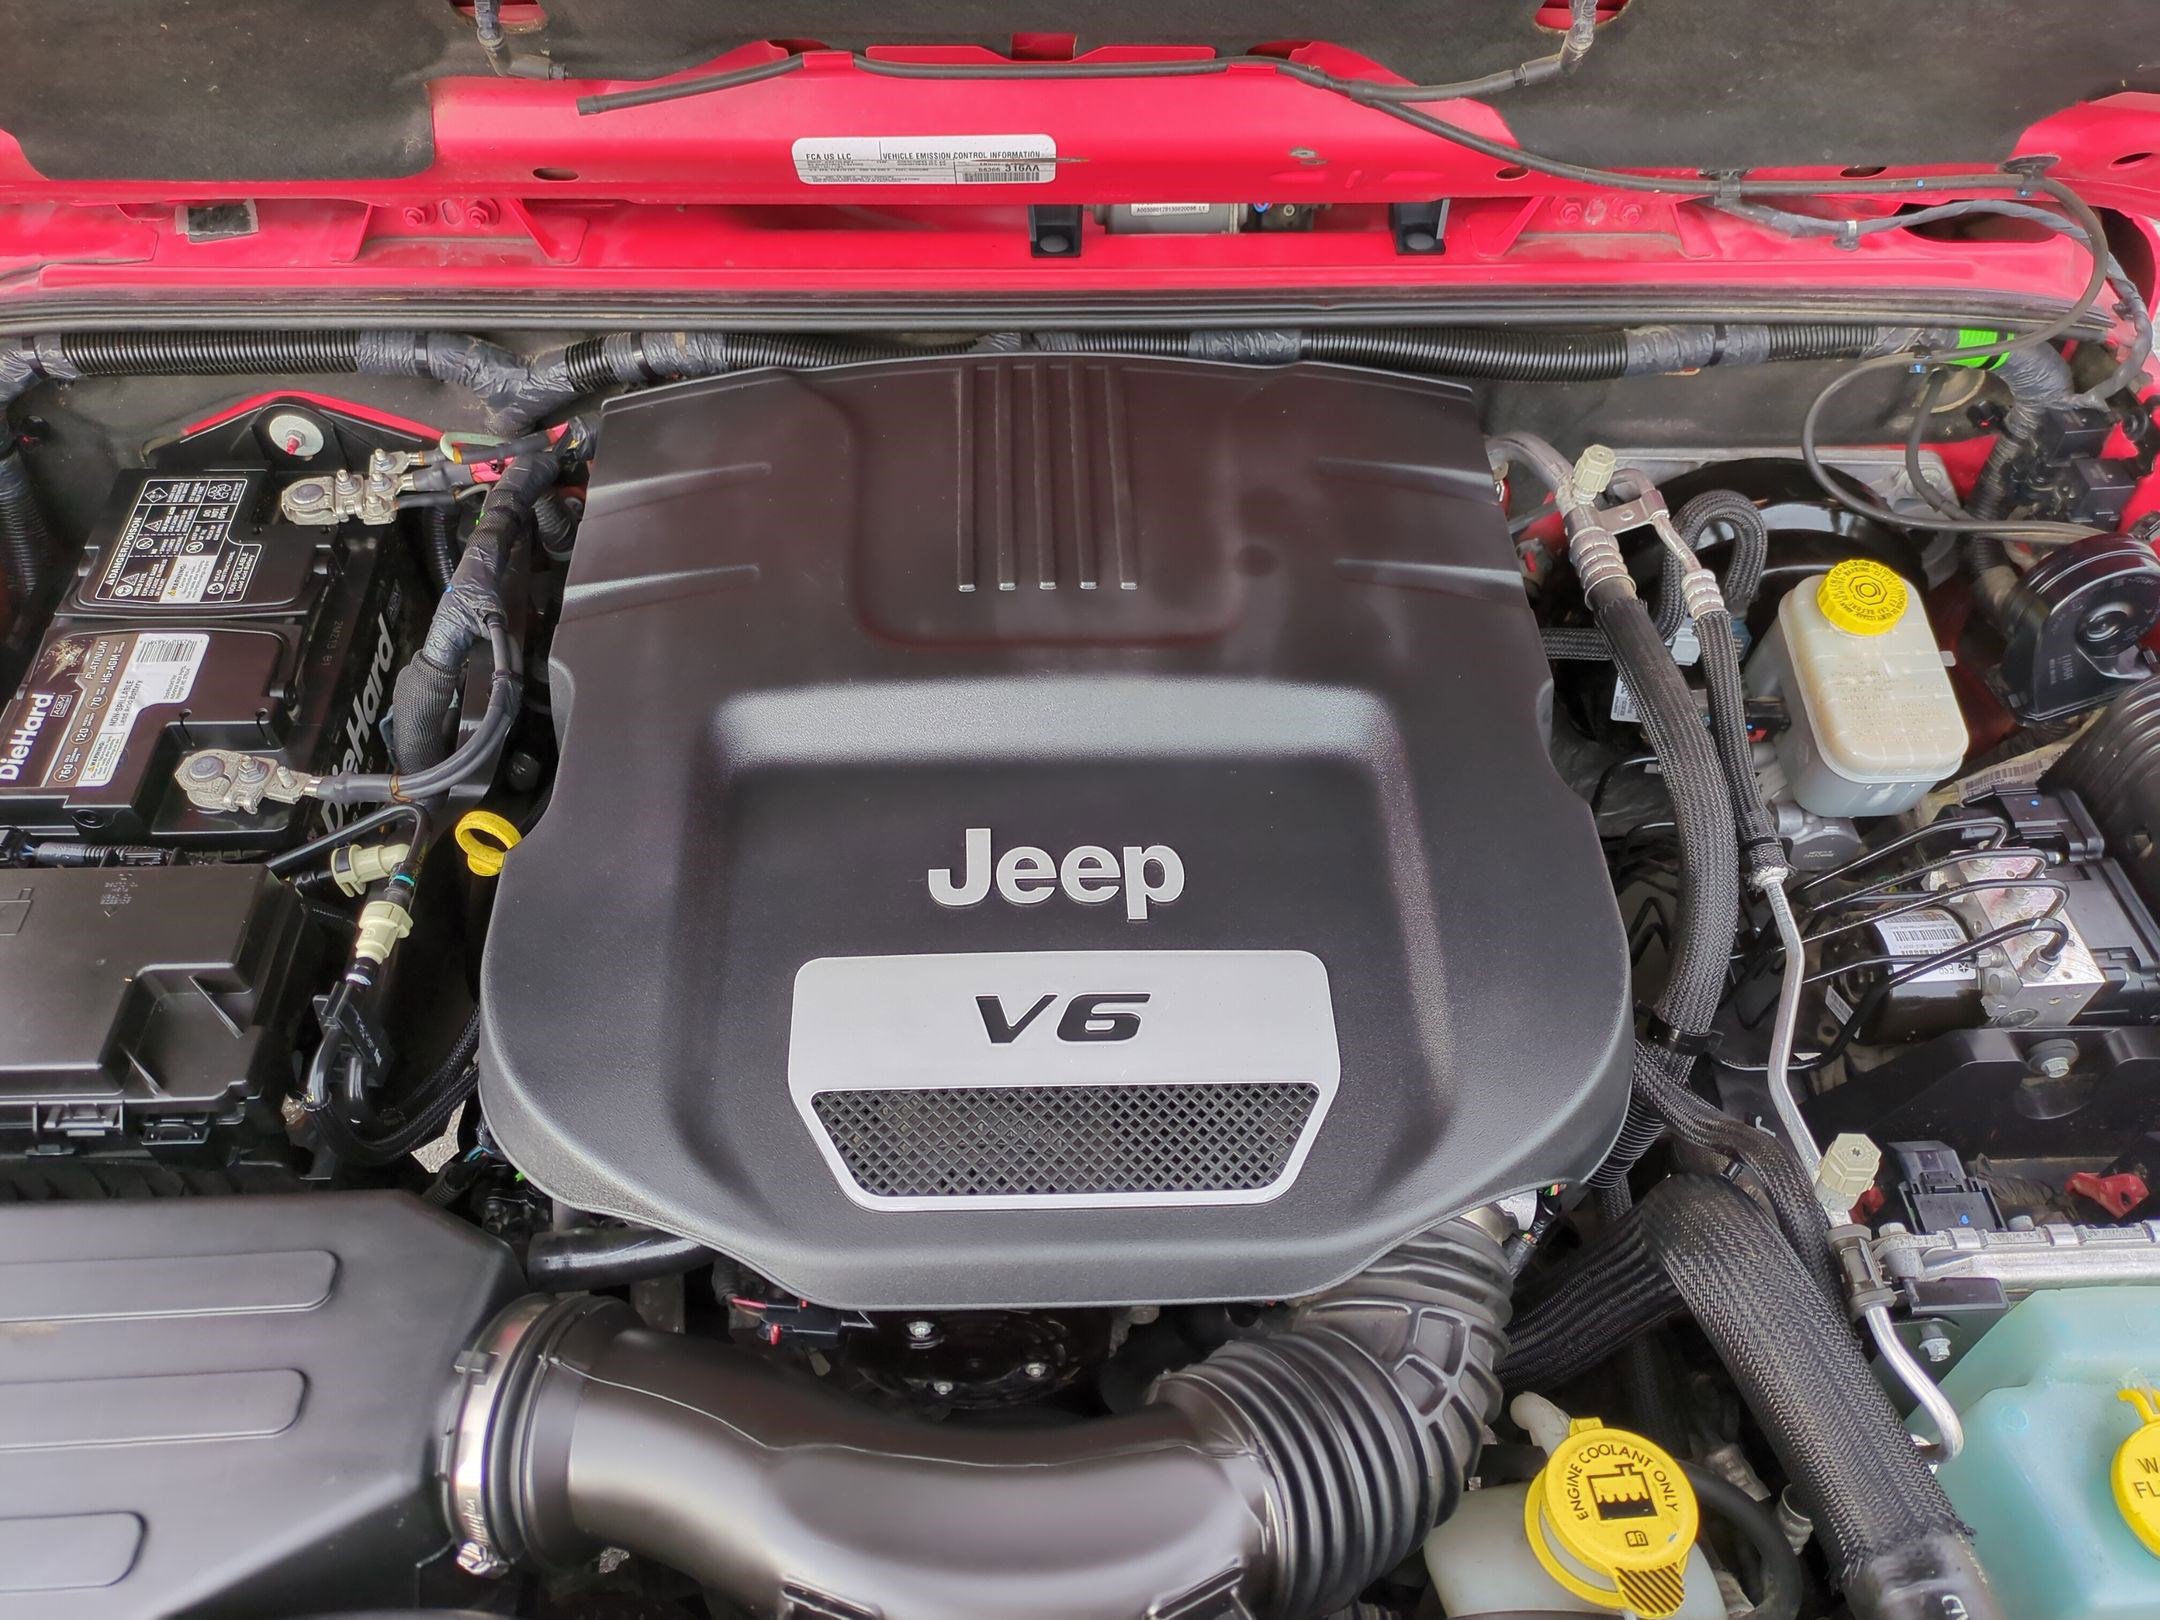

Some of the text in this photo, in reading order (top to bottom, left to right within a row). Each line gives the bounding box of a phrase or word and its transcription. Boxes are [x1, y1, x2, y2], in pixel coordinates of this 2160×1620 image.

[806, 153, 852, 161] FCA US LLC
[882, 151, 1040, 160] VEHICLE EMISSION CONTROL INFORMATION
[108, 518, 143, 578] DANGER/POISON
[228, 552, 249, 594] NON-SPILLABLE
[84, 641, 109, 679] PLATINUM
[99, 654, 121, 683] H6-AGM
[90, 696, 103, 706] 70
[108, 680, 134, 726] NON-SPILLABLE
[0, 693, 55, 780] DieHard
[75, 728, 90, 741] 120
[58, 764, 74, 779] 760
[928, 828, 1185, 921] Jeep
[975, 992, 1151, 1043] V6
[1567, 1444, 1678, 1521] ENGINE COOLANT ONLY
